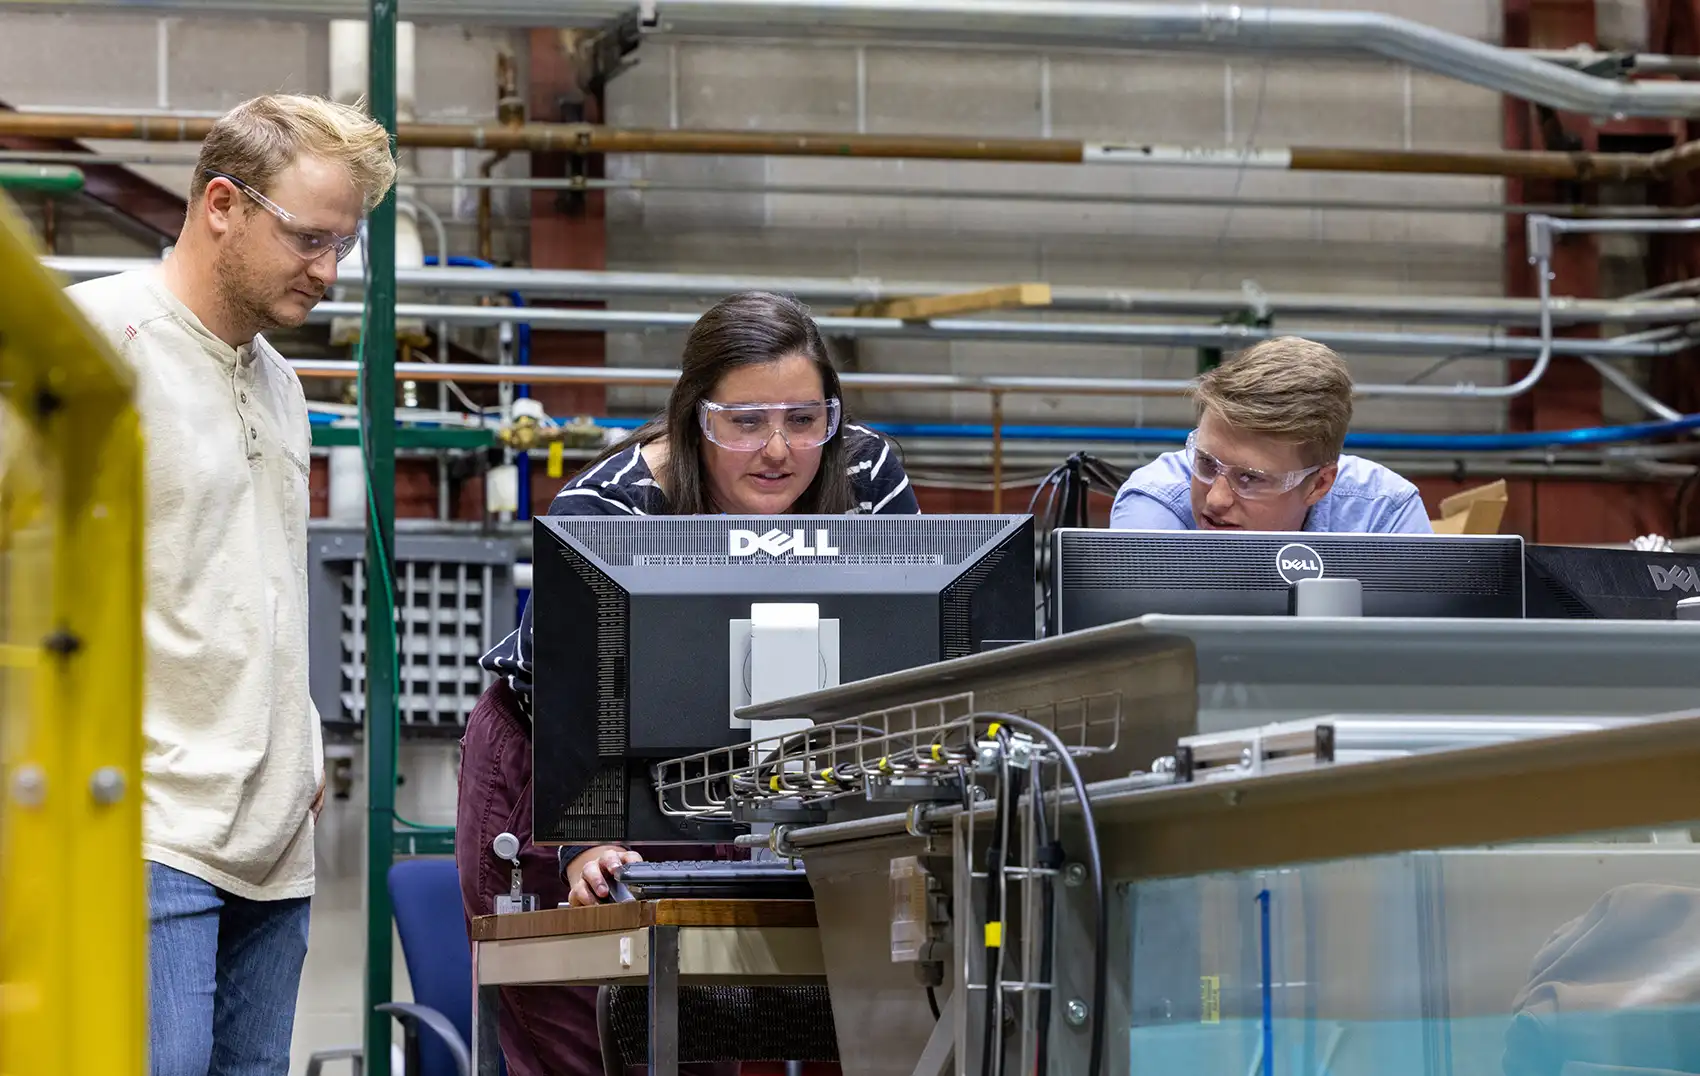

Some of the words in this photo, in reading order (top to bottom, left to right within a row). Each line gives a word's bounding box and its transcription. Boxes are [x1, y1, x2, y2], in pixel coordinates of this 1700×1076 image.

[729, 528, 839, 557] DELL
[1281, 559, 1319, 571] DELL
[1647, 564, 1700, 592] DEL
